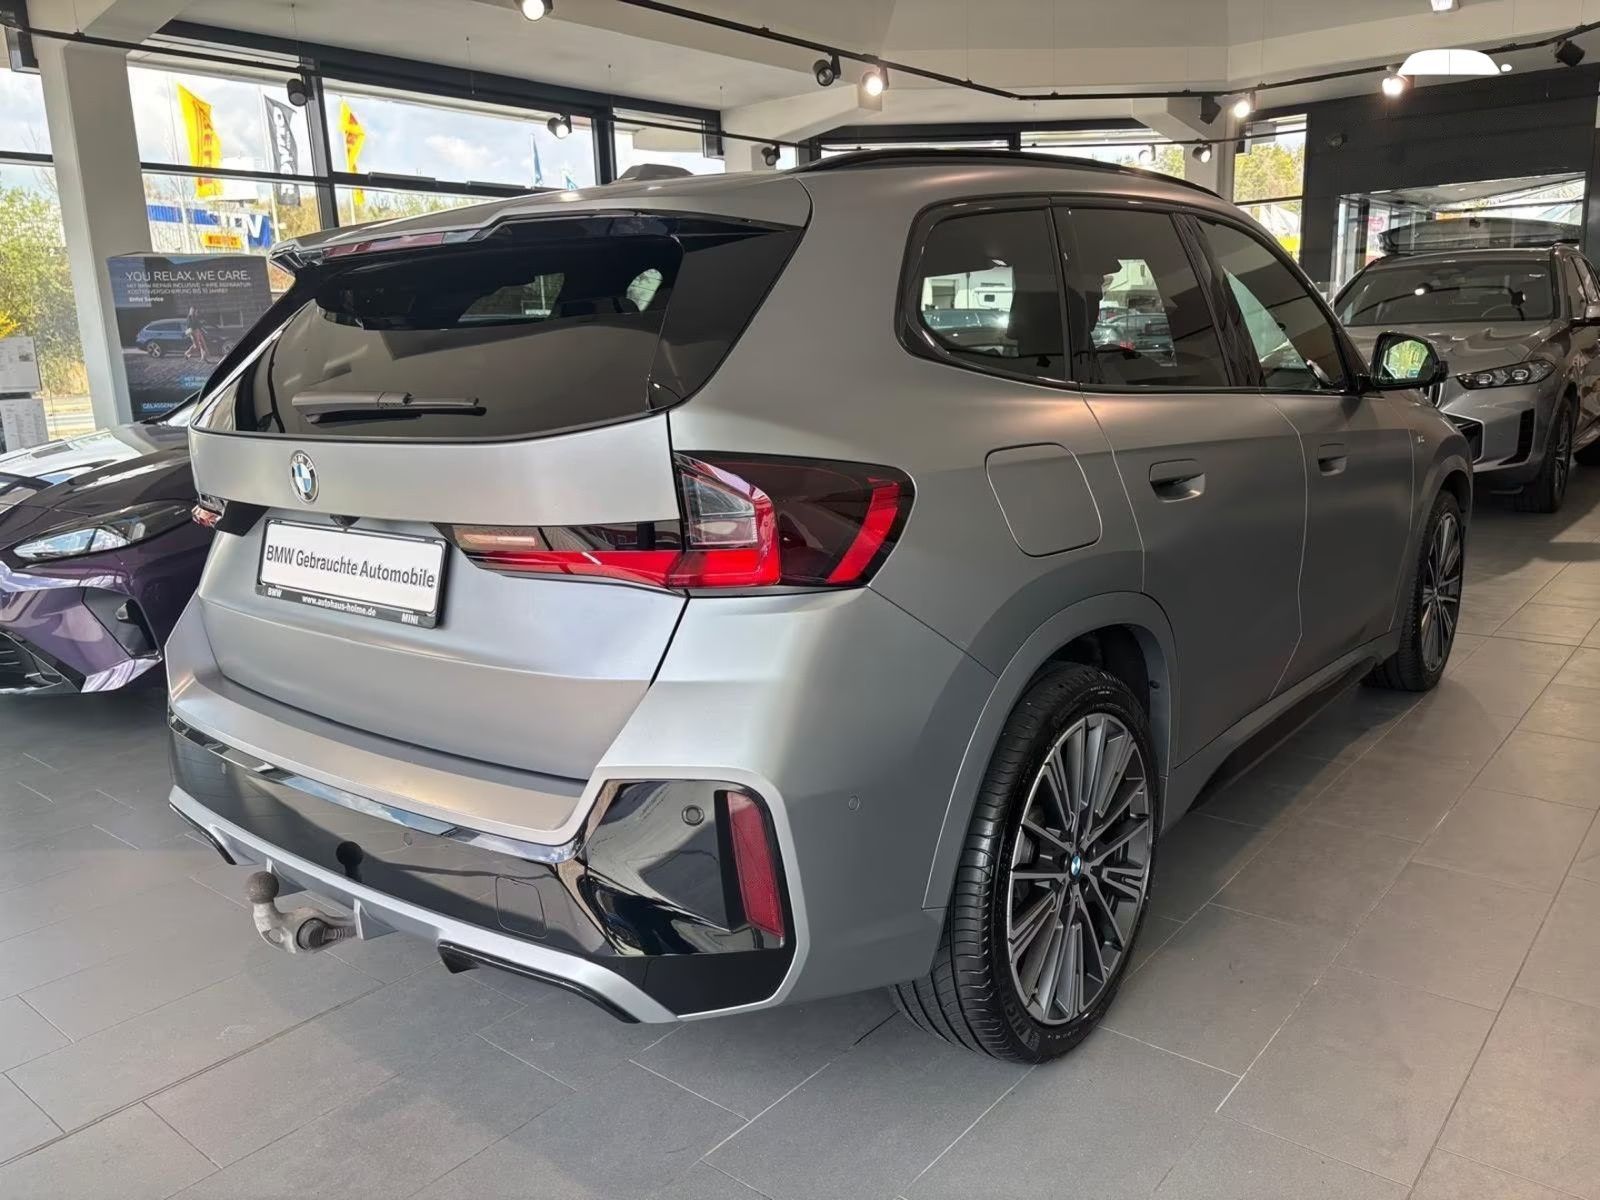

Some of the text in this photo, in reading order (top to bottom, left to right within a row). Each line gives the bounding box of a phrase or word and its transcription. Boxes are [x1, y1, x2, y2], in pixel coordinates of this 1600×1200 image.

[126, 270, 251, 282] YOU RELAX. WE CARE.
[266, 545, 435, 588] BMW Gebrauchte Automobile
[267, 587, 283, 598] BMW
[401, 613, 419, 625] MINI
